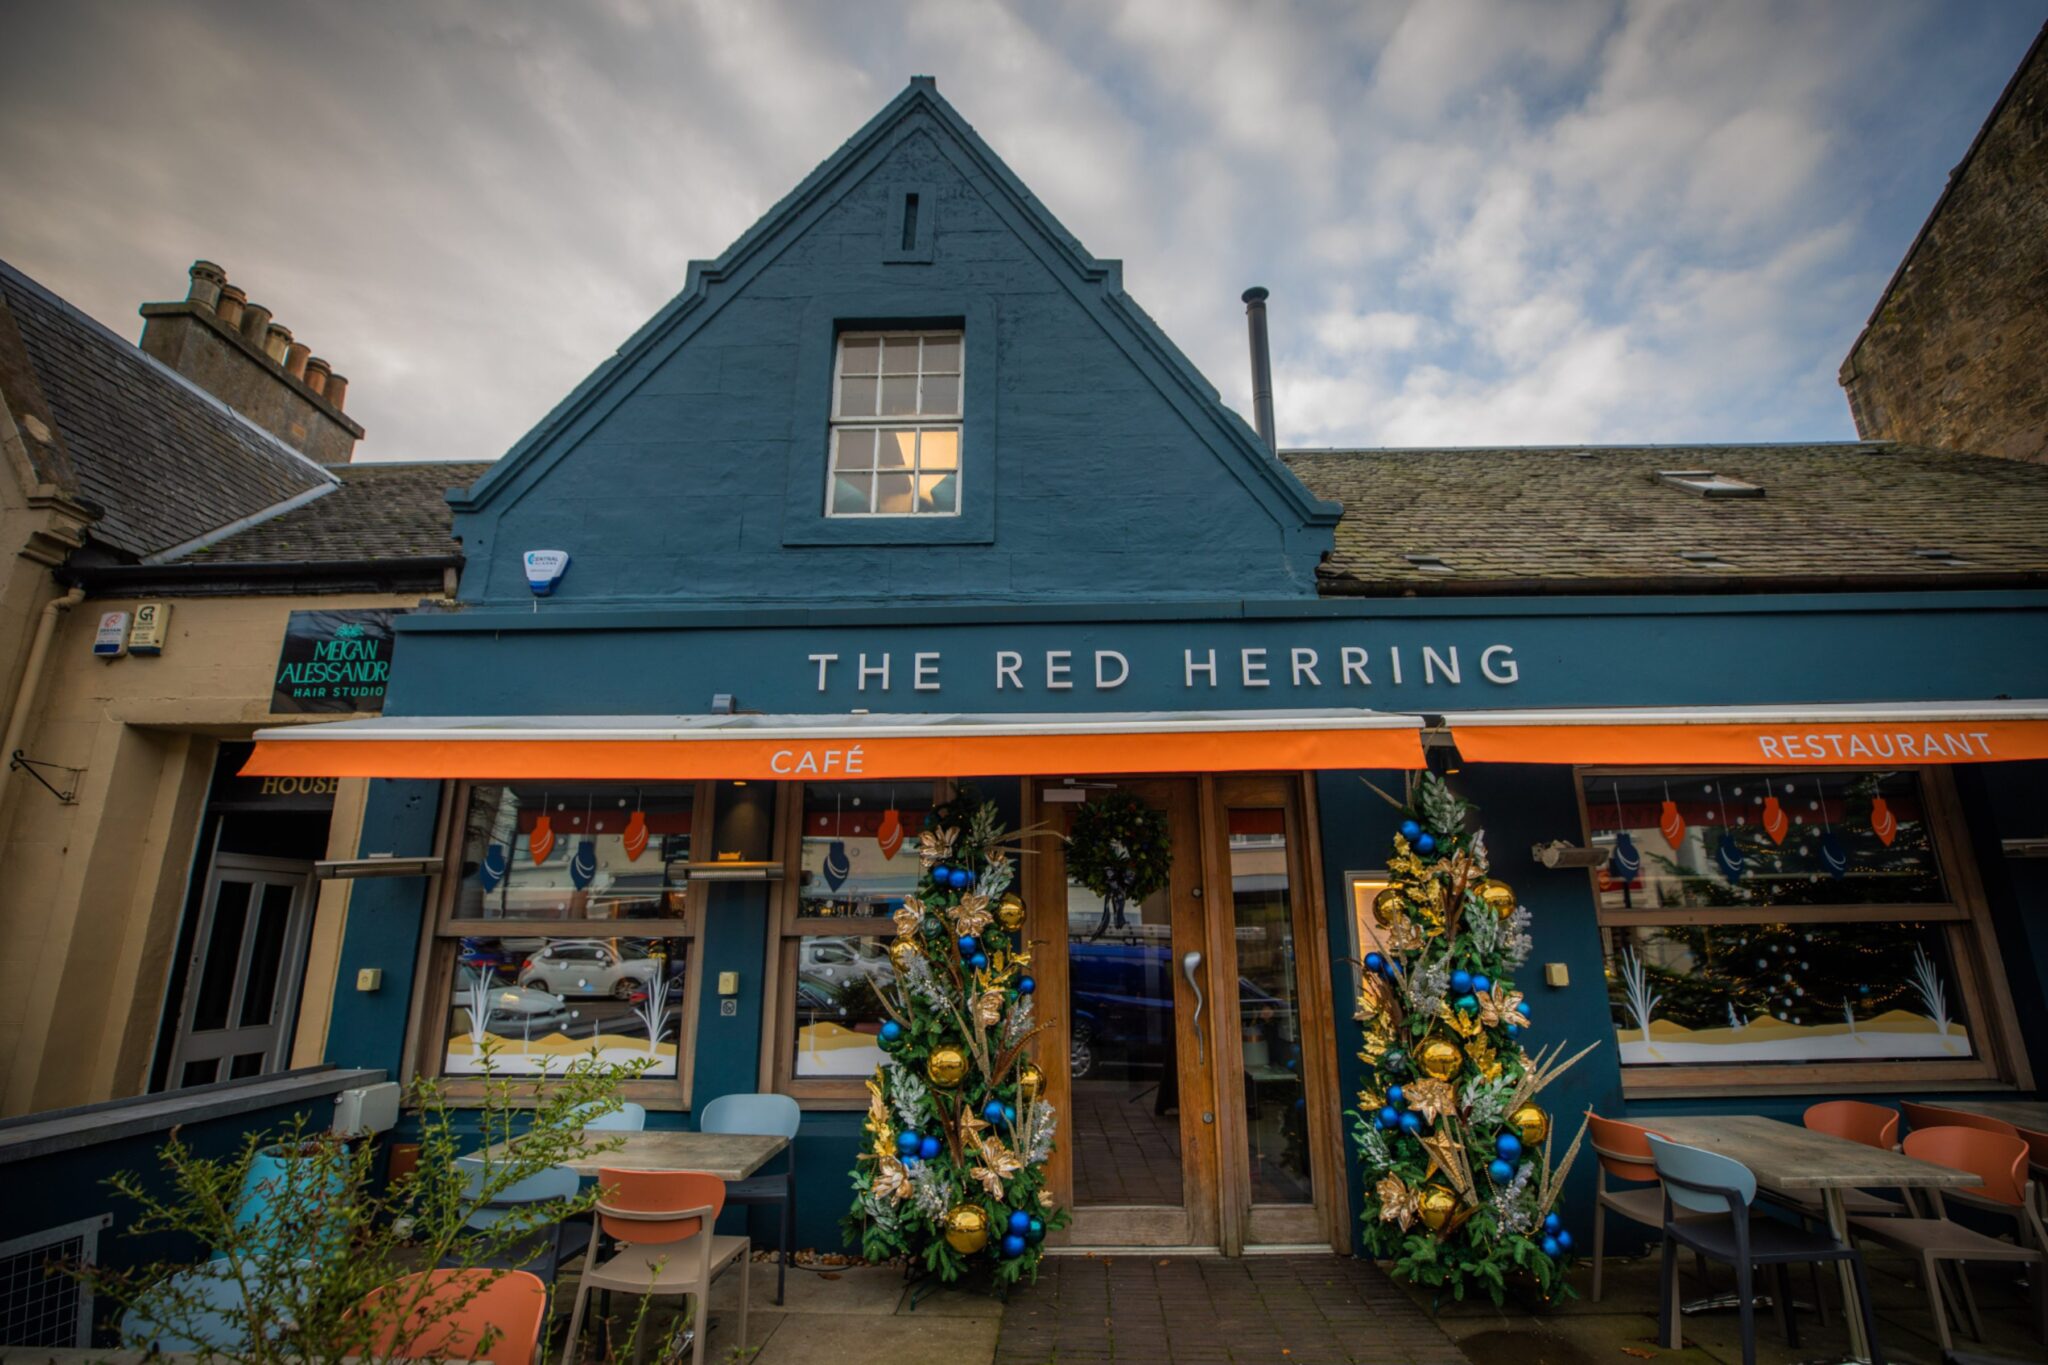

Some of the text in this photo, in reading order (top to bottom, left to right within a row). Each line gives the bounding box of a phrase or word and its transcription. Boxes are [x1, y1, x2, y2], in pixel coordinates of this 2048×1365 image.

[313, 640, 379, 661] MEGAN
[278, 661, 391, 684] ALESSANDR
[808, 644, 1519, 691] THE RED HERRING
[293, 686, 384, 698] HAIR STUDIO
[1758, 733, 1992, 759] RESTAURANT
[770, 744, 864, 774] CAFÉ
